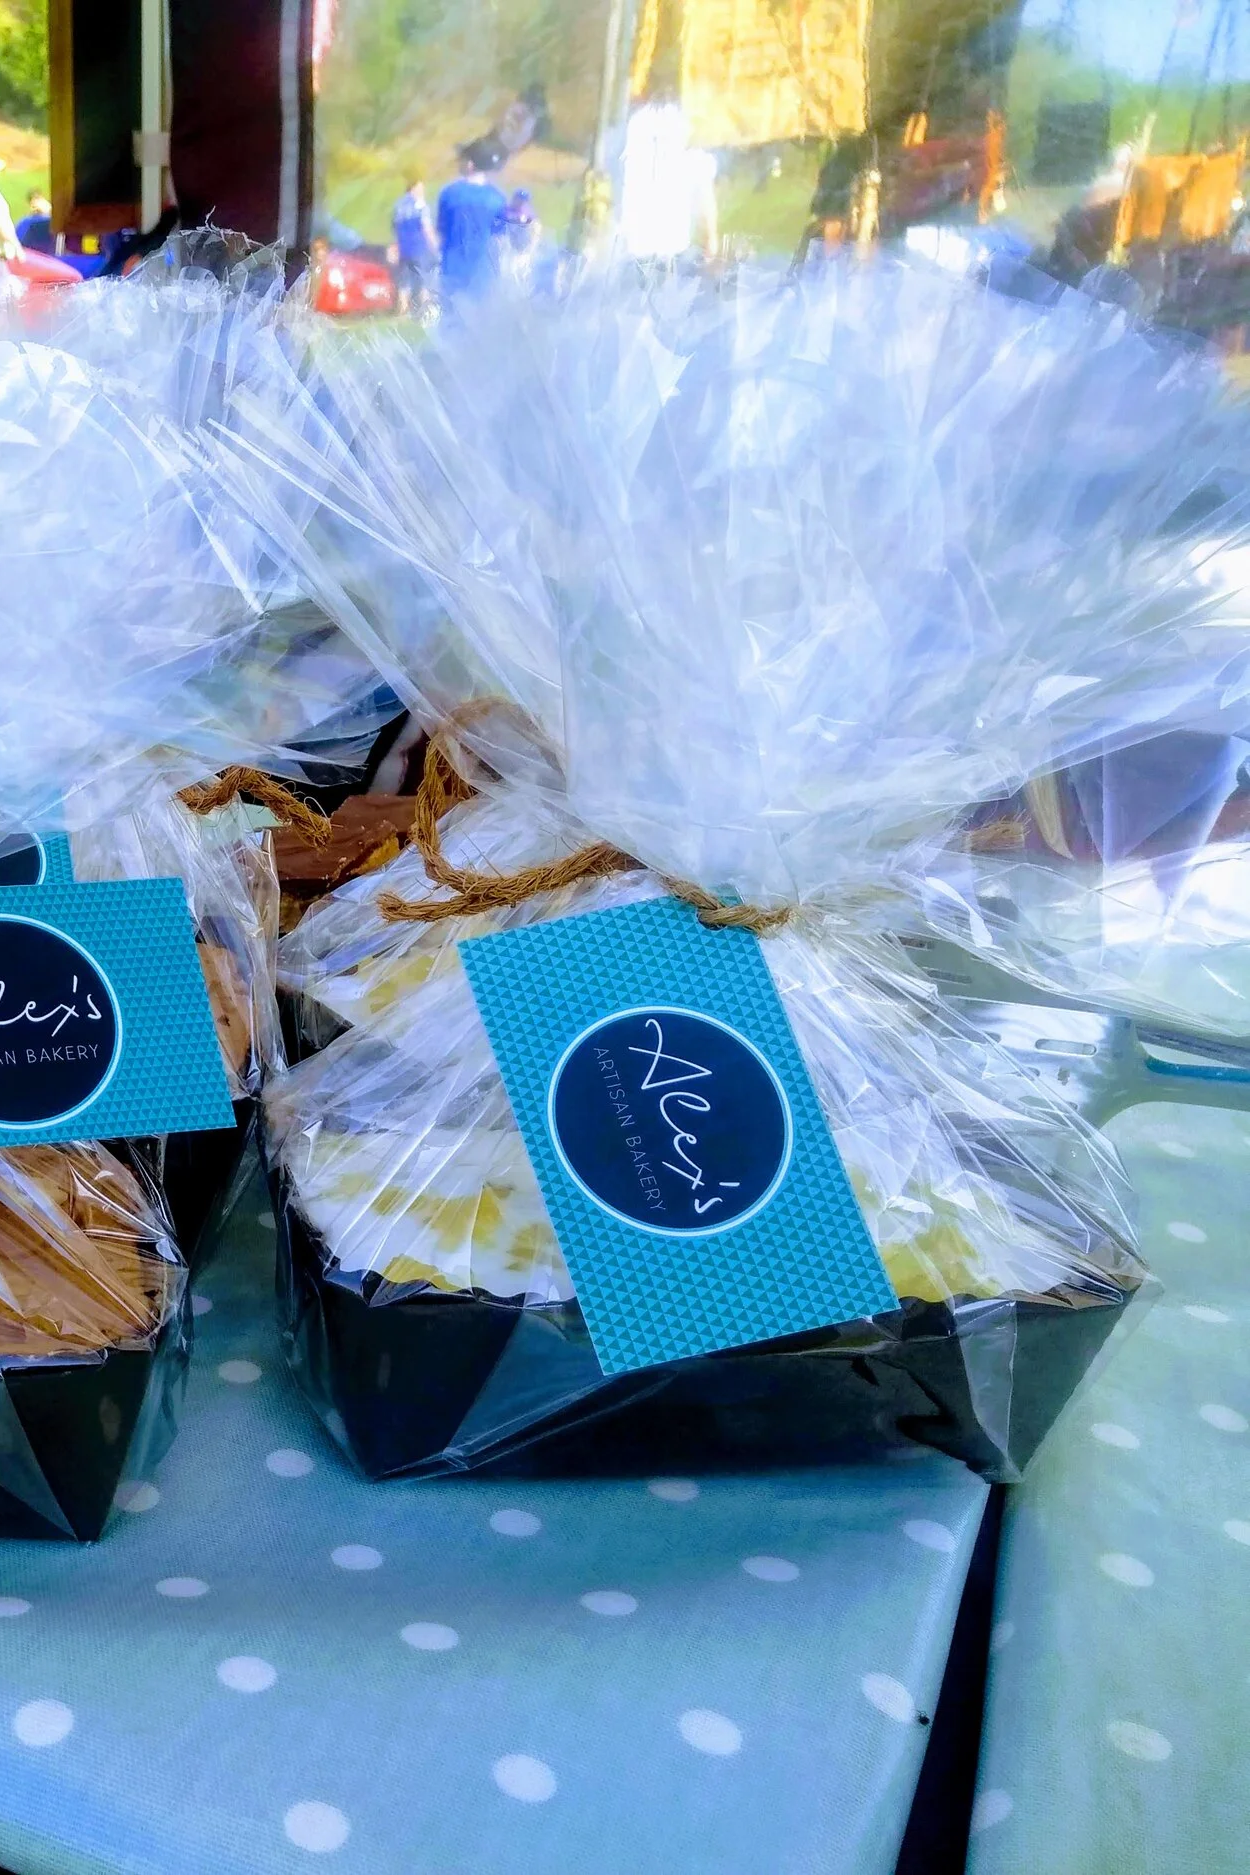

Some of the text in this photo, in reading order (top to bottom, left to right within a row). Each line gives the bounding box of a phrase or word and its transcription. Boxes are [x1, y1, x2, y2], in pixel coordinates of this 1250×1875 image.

[26, 1043, 99, 1064] BAKERY
[593, 1047, 667, 1211] ARTISAN BAKERY
[628, 1018, 740, 1213] Alex's
